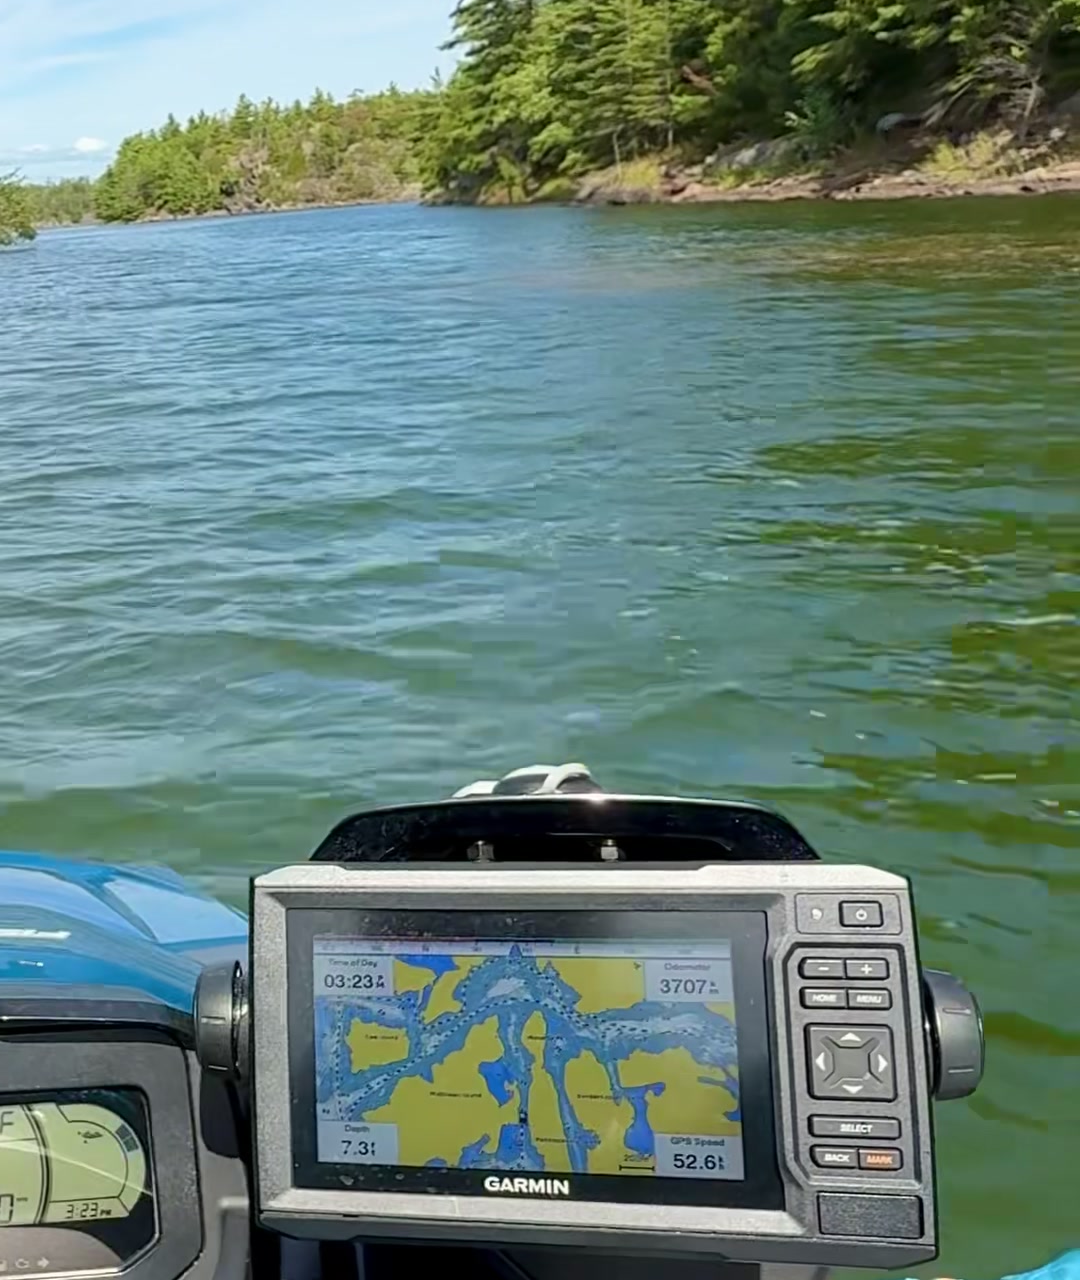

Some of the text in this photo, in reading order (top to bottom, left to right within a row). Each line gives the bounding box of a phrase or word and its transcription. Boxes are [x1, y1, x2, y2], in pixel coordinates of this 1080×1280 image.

[351, 958, 361, 967] of
[361, 959, 378, 968] Day
[324, 974, 373, 989] 03:23
[660, 978, 707, 994] 3707
[812, 994, 837, 1002] HOME
[856, 994, 882, 1003] MENU
[0, 1111, 14, 1135] F
[840, 1123, 873, 1133] SELECT
[344, 1124, 370, 1134] Depth
[341, 1140, 368, 1156] 7.3
[671, 1137, 725, 1148] GPS Speed
[673, 1154, 716, 1170] 52.6
[824, 1153, 850, 1162] BACK
[866, 1155, 893, 1164] MARK
[484, 1176, 569, 1195] GARMIN
[65, 1202, 98, 1219] 3:23
